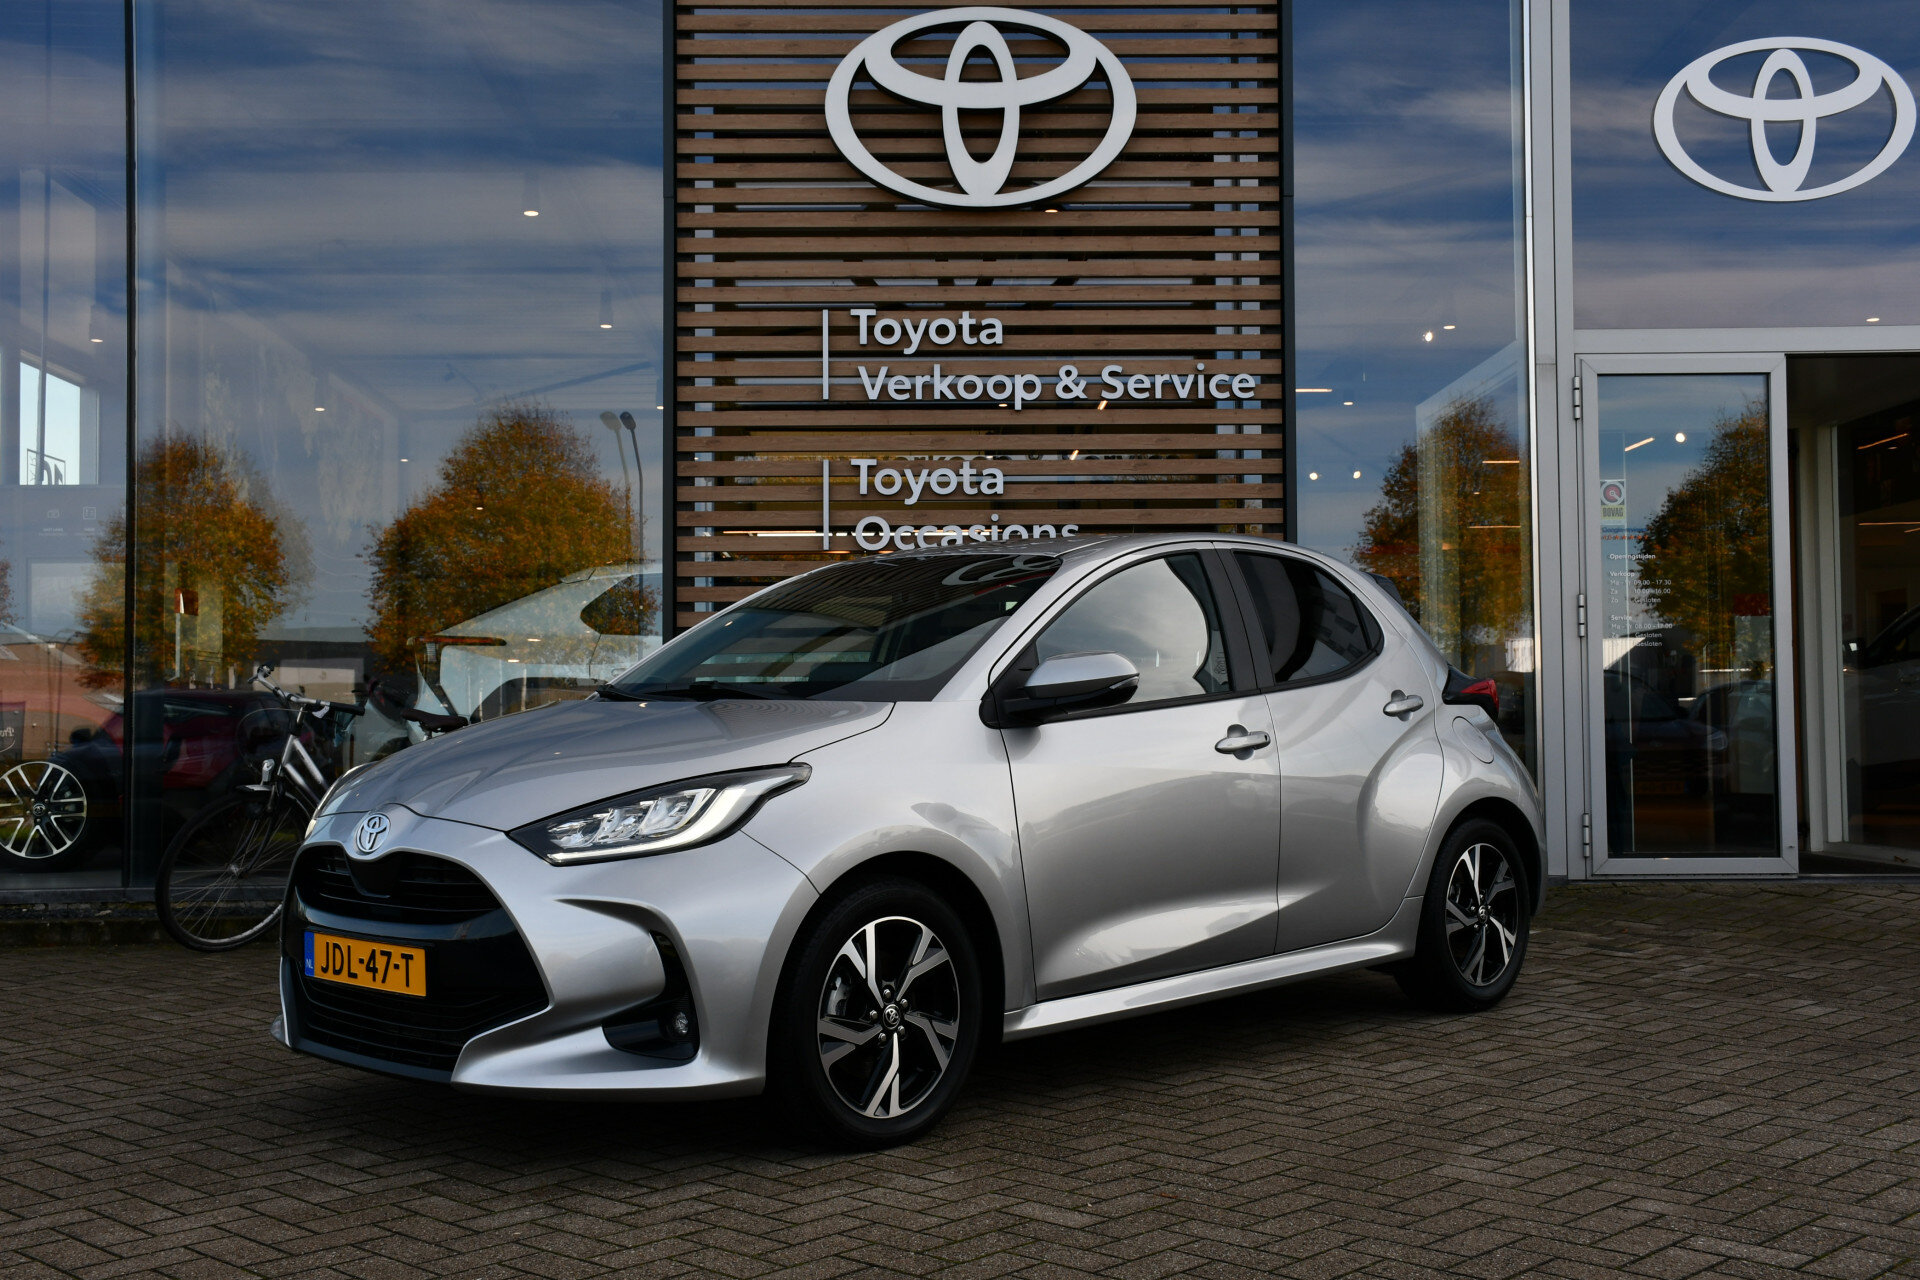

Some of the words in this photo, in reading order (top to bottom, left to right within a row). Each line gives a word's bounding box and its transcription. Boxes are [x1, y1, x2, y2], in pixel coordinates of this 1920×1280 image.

[850, 308, 1003, 354] Toyota
[857, 363, 1042, 410] Verkoop
[1055, 365, 1088, 399] &
[1100, 362, 1256, 399] Service
[850, 458, 1004, 505] Toyota
[1602, 507, 1624, 517] BOVAG
[1609, 570, 1635, 578] Verkoop
[306, 958, 314, 969] NL
[320, 941, 414, 988] JDL-47-T
